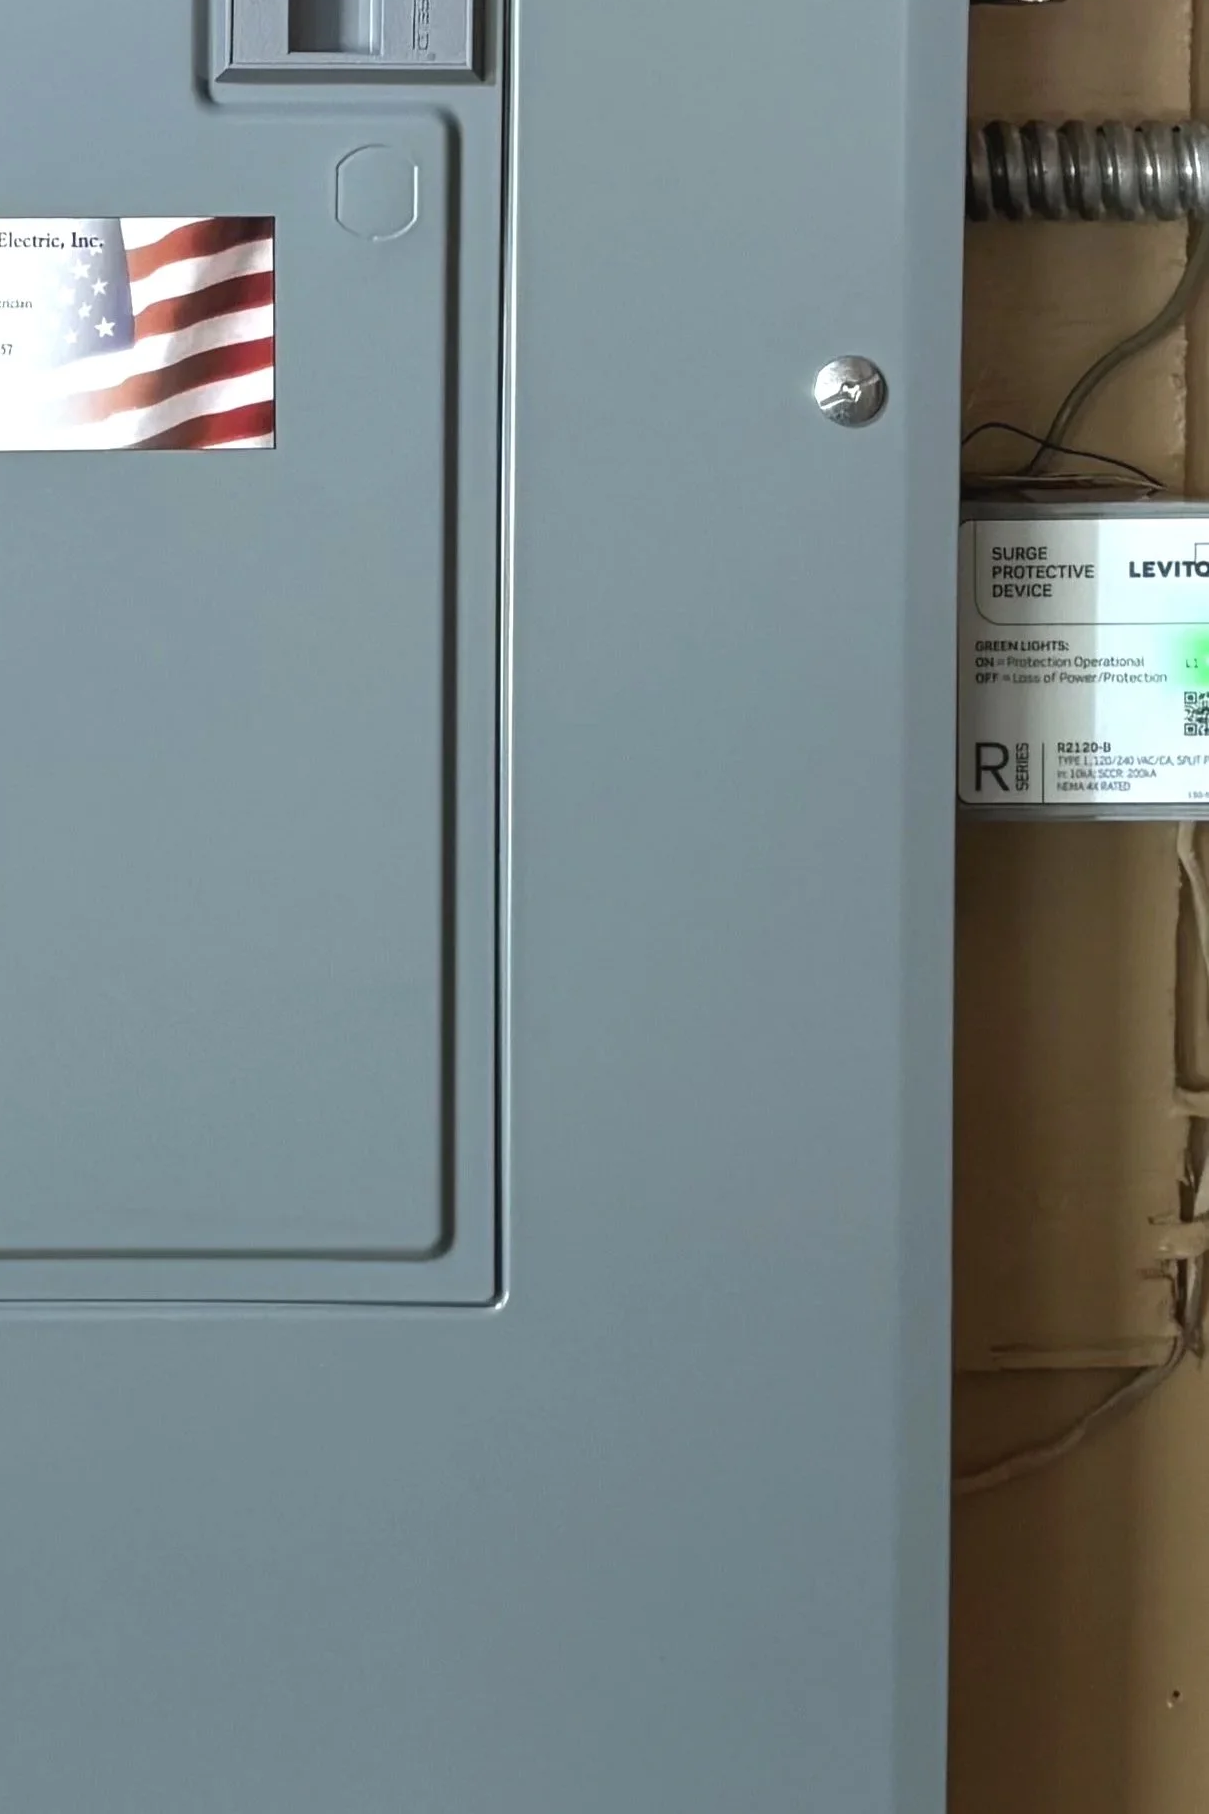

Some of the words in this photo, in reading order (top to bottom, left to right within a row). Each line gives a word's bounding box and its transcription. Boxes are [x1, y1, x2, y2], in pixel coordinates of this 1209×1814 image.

[70, 231, 105, 249] Inc.
[991, 546, 1048, 561] SURGE
[991, 564, 1095, 580] PROTECTIVE
[991, 583, 1053, 598] DEVICE
[974, 640, 1018, 652] GREEN
[1020, 640, 1070, 652] LIGHTS:
[974, 656, 995, 668] ON
[1006, 656, 1071, 668] Protection
[1073, 655, 1146, 669] Operational
[974, 672, 999, 684] OFF
[1012, 672, 1040, 684] Loss
[1043, 671, 1056, 684] of
[1059, 671, 1168, 685] Power/Protection
[1056, 741, 1112, 753] R2120-B
[974, 741, 1010, 793] R
[1015, 741, 1030, 792] SERIES
[1057, 755, 1080, 767] TYPE
[1176, 755, 1202, 767] SPLIT
[1056, 781, 1086, 792] NEMA
[1100, 781, 1131, 792] RATED
